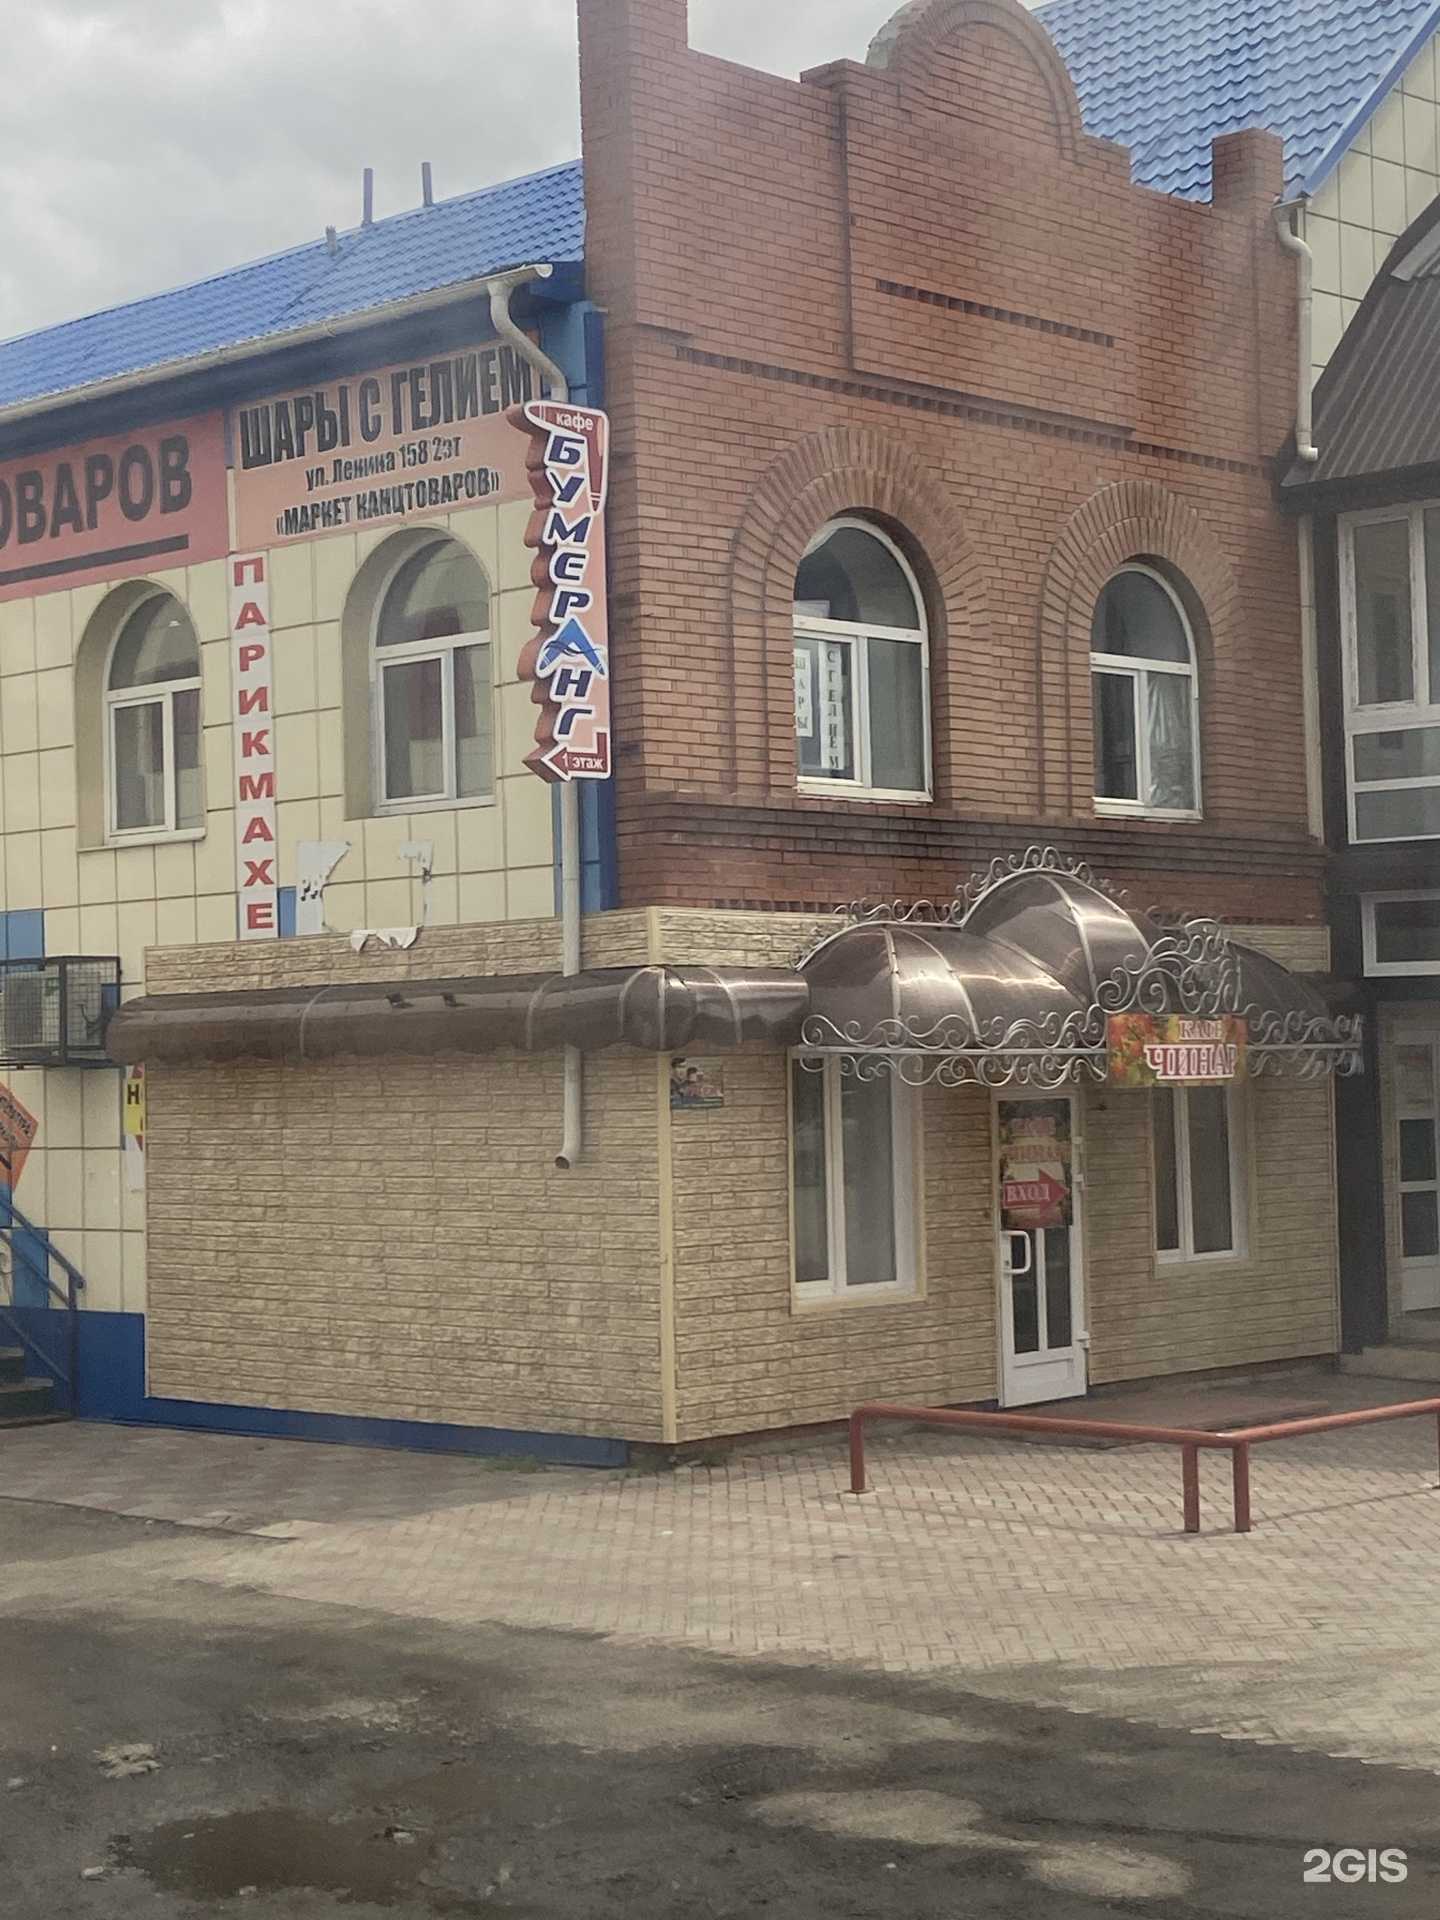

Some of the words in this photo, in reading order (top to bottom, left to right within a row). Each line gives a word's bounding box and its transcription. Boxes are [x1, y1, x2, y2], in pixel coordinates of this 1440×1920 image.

[239, 386, 351, 471] ШАРЫ
[358, 377, 382, 443] С
[390, 345, 533, 436] ГЕЛИЕМ
[556, 411, 595, 432] кафе
[305, 468, 330, 492] ул.
[332, 451, 396, 484] Ленина
[400, 439, 429, 469] 158
[275, 496, 352, 537] «МАРКЕТ
[356, 467, 500, 521] КАНЦТОВАРОВ»
[539, 434, 605, 736] БУМЕРАНГ
[233, 556, 276, 931] ПАРИКМАХЕ
[572, 757, 605, 771] этаж
[1005, 1183, 1052, 1202] ВХОД
